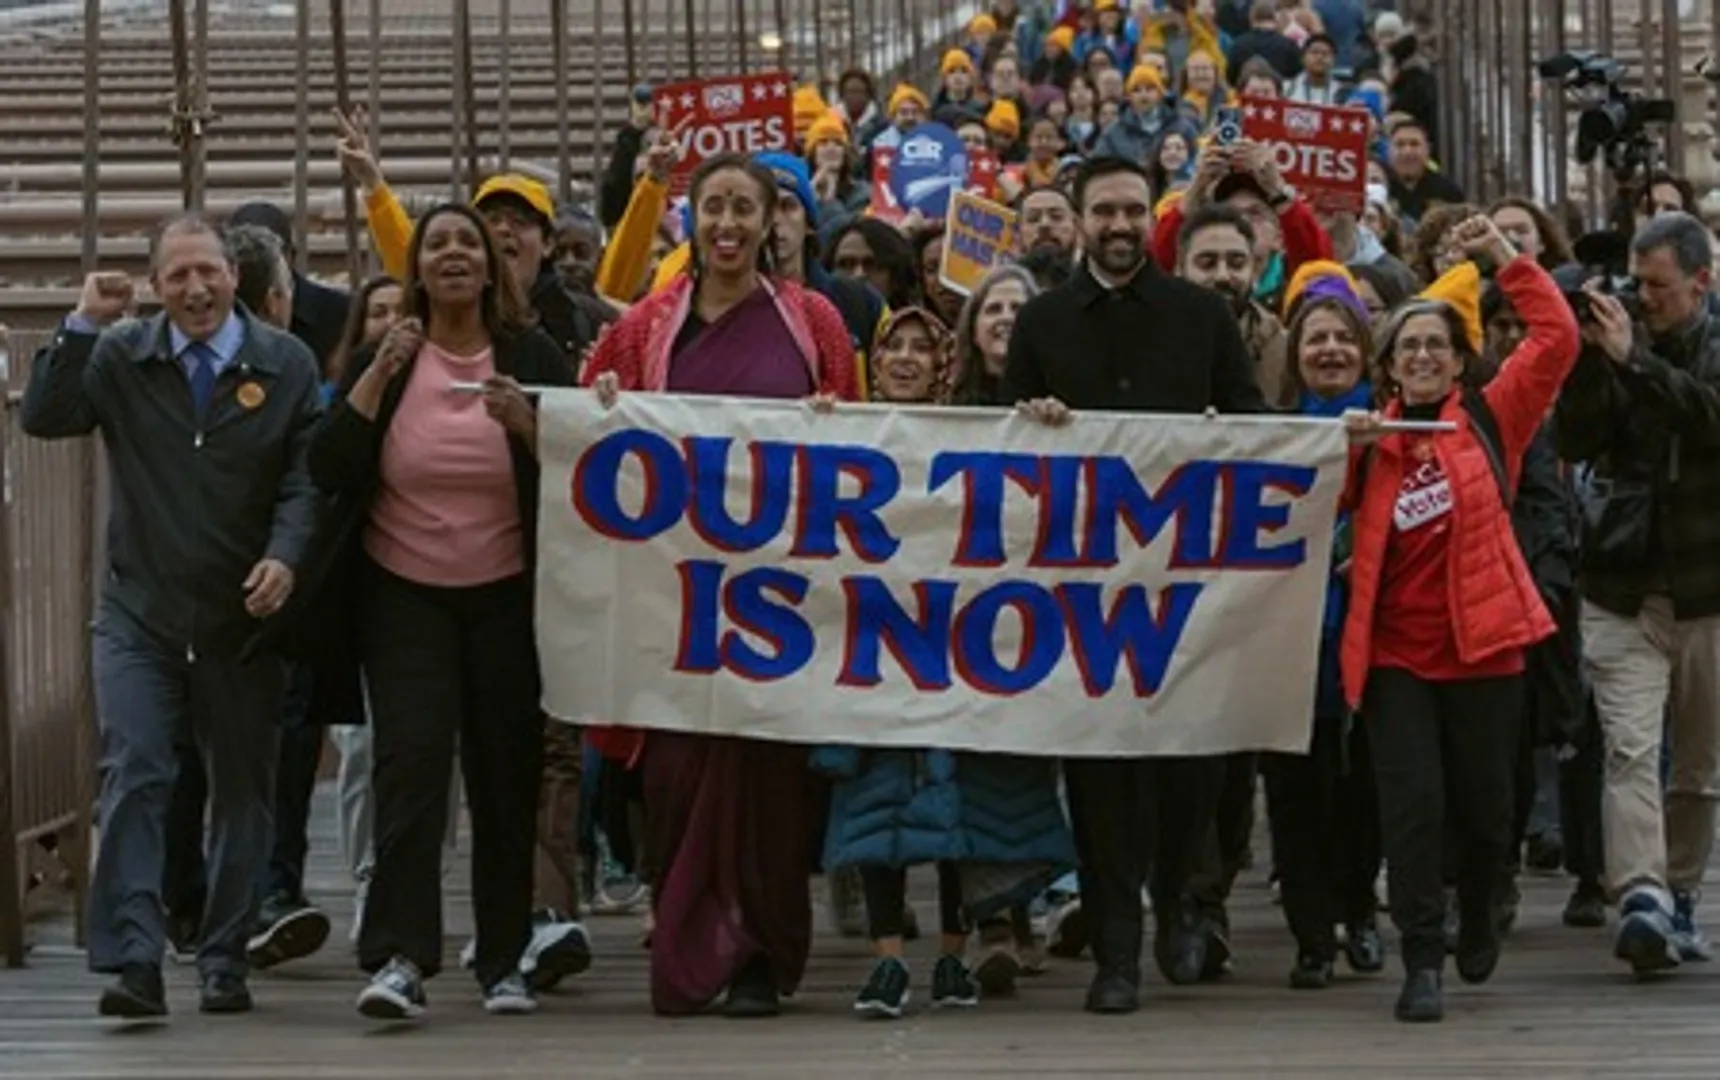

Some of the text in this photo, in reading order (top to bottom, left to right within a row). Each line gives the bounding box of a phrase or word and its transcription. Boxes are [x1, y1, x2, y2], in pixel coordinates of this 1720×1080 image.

[1264, 139, 1358, 182] OTES
[572, 428, 1319, 571] OUR TIME
[673, 560, 1204, 698] IS NOW
